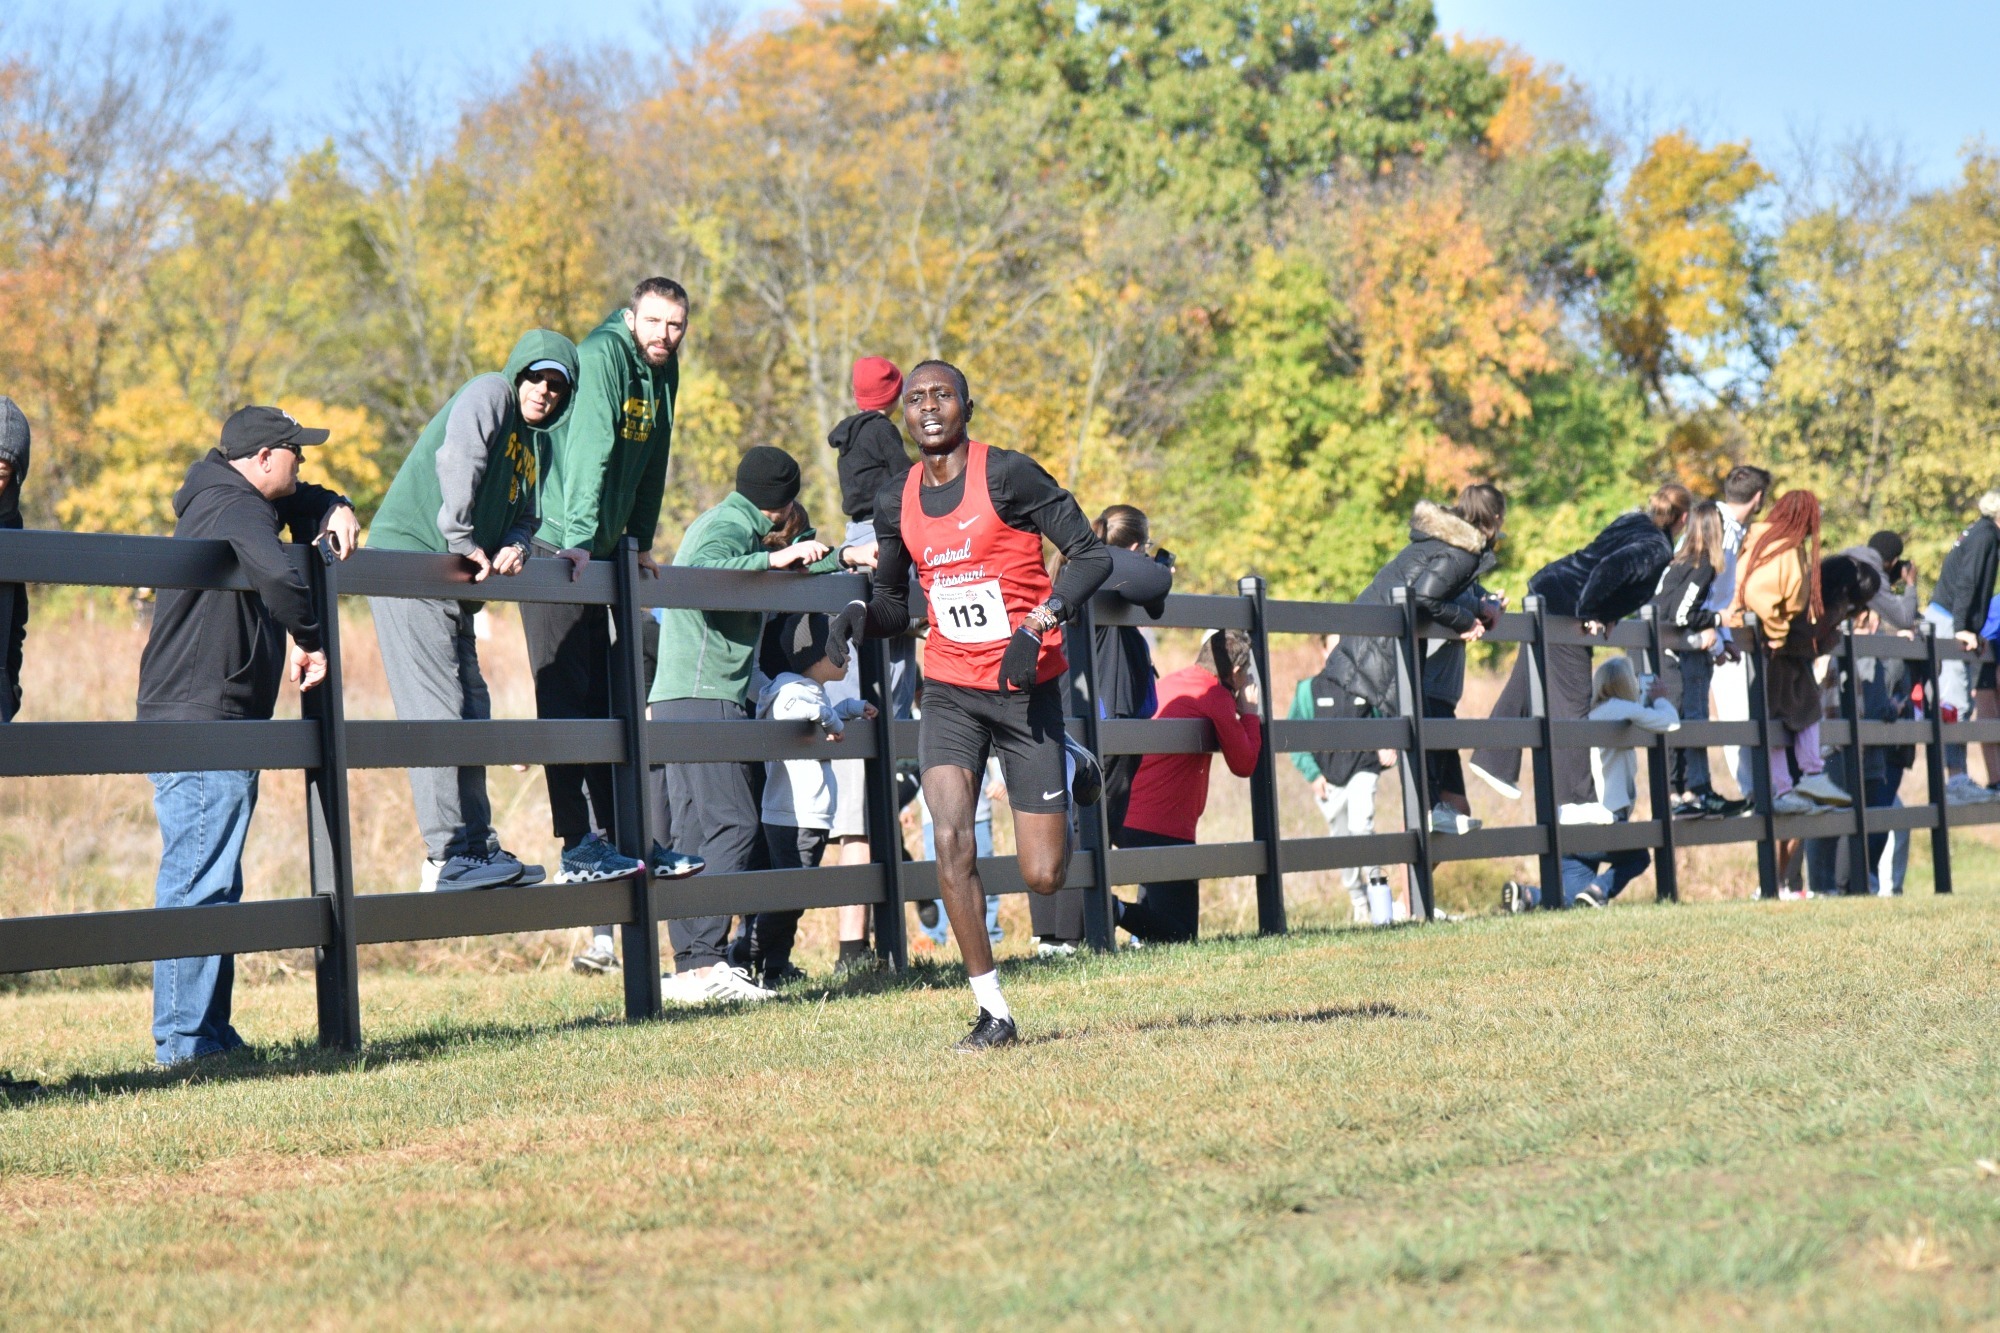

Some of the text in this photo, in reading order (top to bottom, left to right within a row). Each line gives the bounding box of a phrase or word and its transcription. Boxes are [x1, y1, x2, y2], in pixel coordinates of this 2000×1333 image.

[924, 538, 971, 566] Central
[934, 566, 985, 587] Missouri
[949, 604, 988, 627] 113
